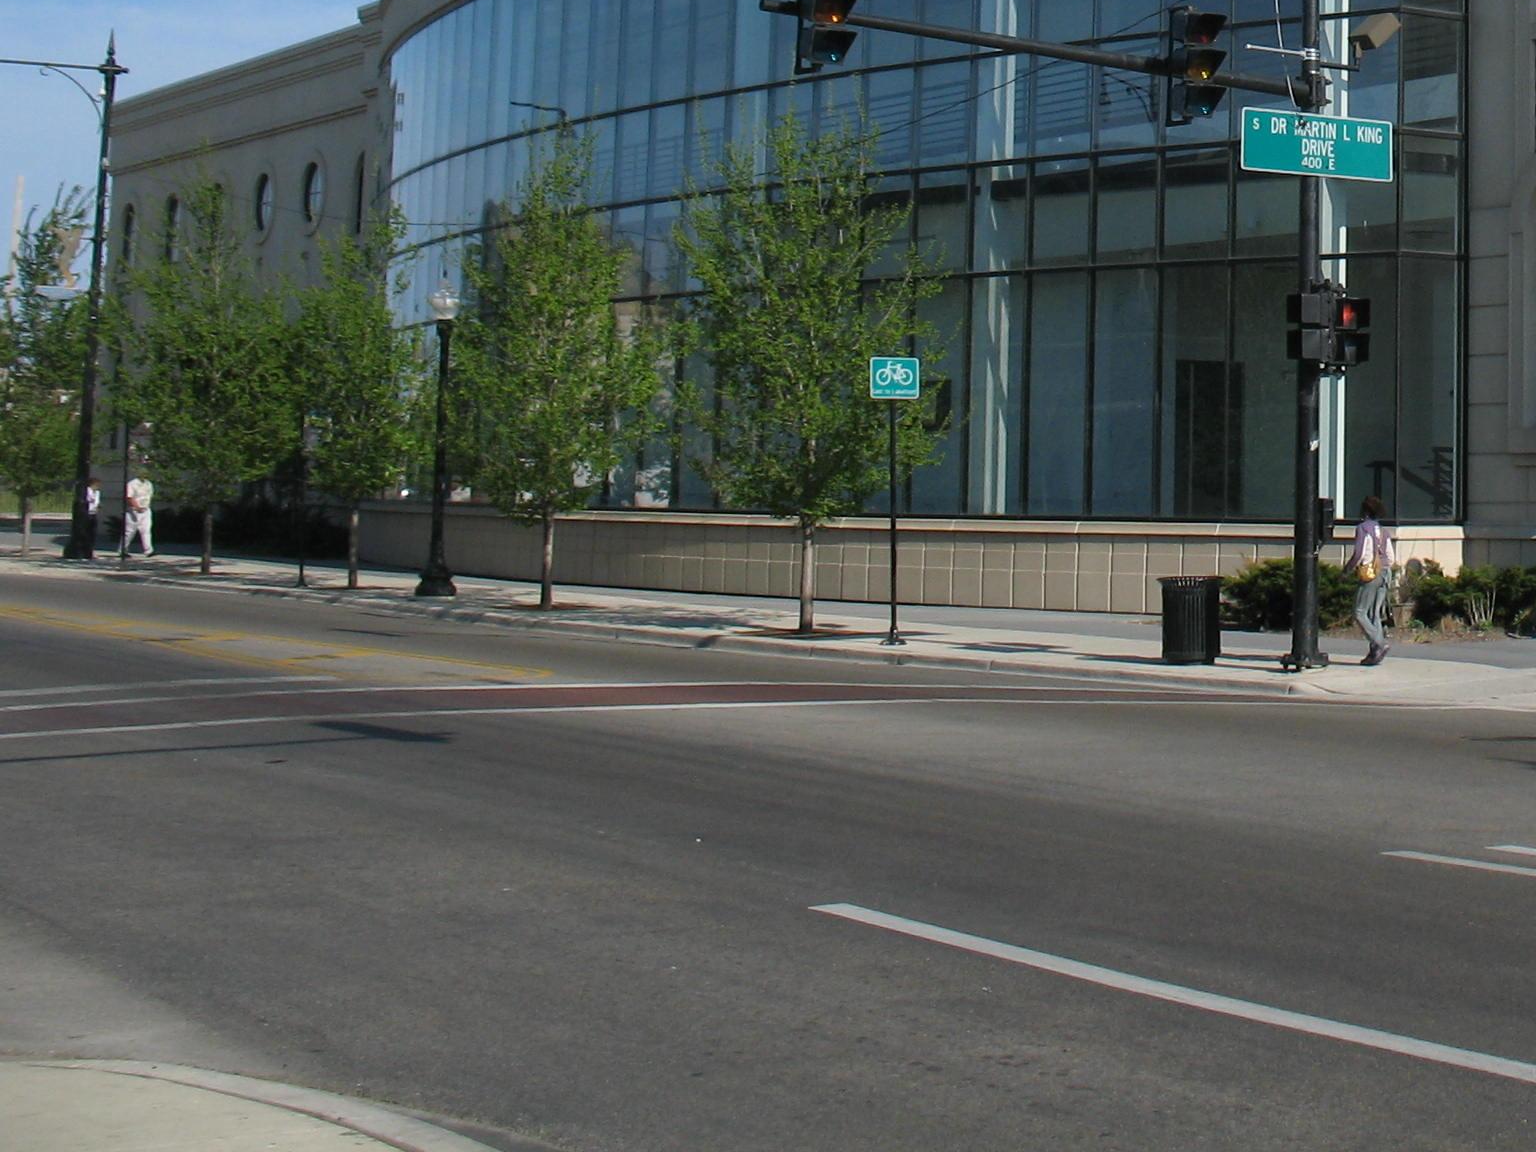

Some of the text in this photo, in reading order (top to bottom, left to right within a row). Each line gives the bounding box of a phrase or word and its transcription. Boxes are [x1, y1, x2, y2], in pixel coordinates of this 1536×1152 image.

[1252, 117, 1383, 144] S DR MARTIN L KING
[1301, 139, 1335, 158] DRIVE
[1301, 157, 1336, 170] 400 E
